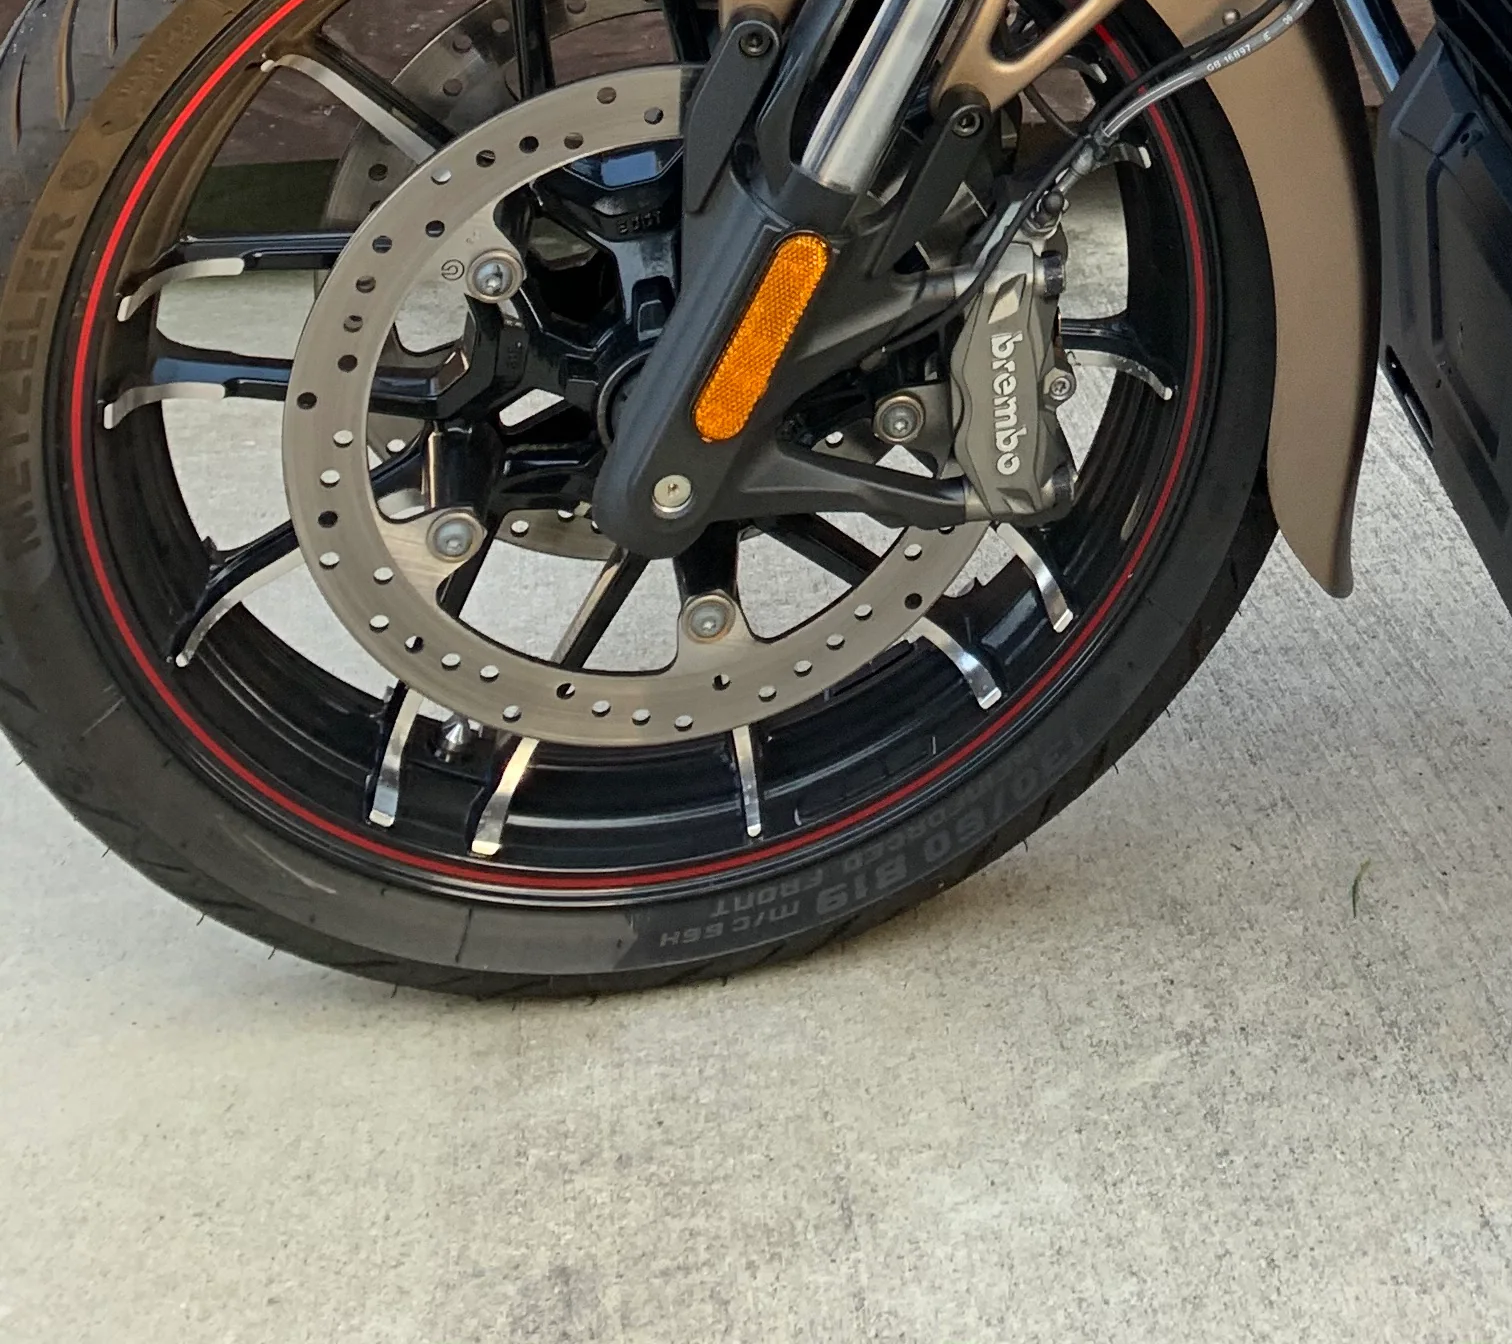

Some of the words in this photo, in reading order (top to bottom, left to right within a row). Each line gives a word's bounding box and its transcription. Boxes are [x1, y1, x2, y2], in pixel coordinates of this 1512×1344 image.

[1206, 59, 1222, 72] GB
[990, 330, 1029, 476] brembo
[708, 869, 824, 919] FRONT
